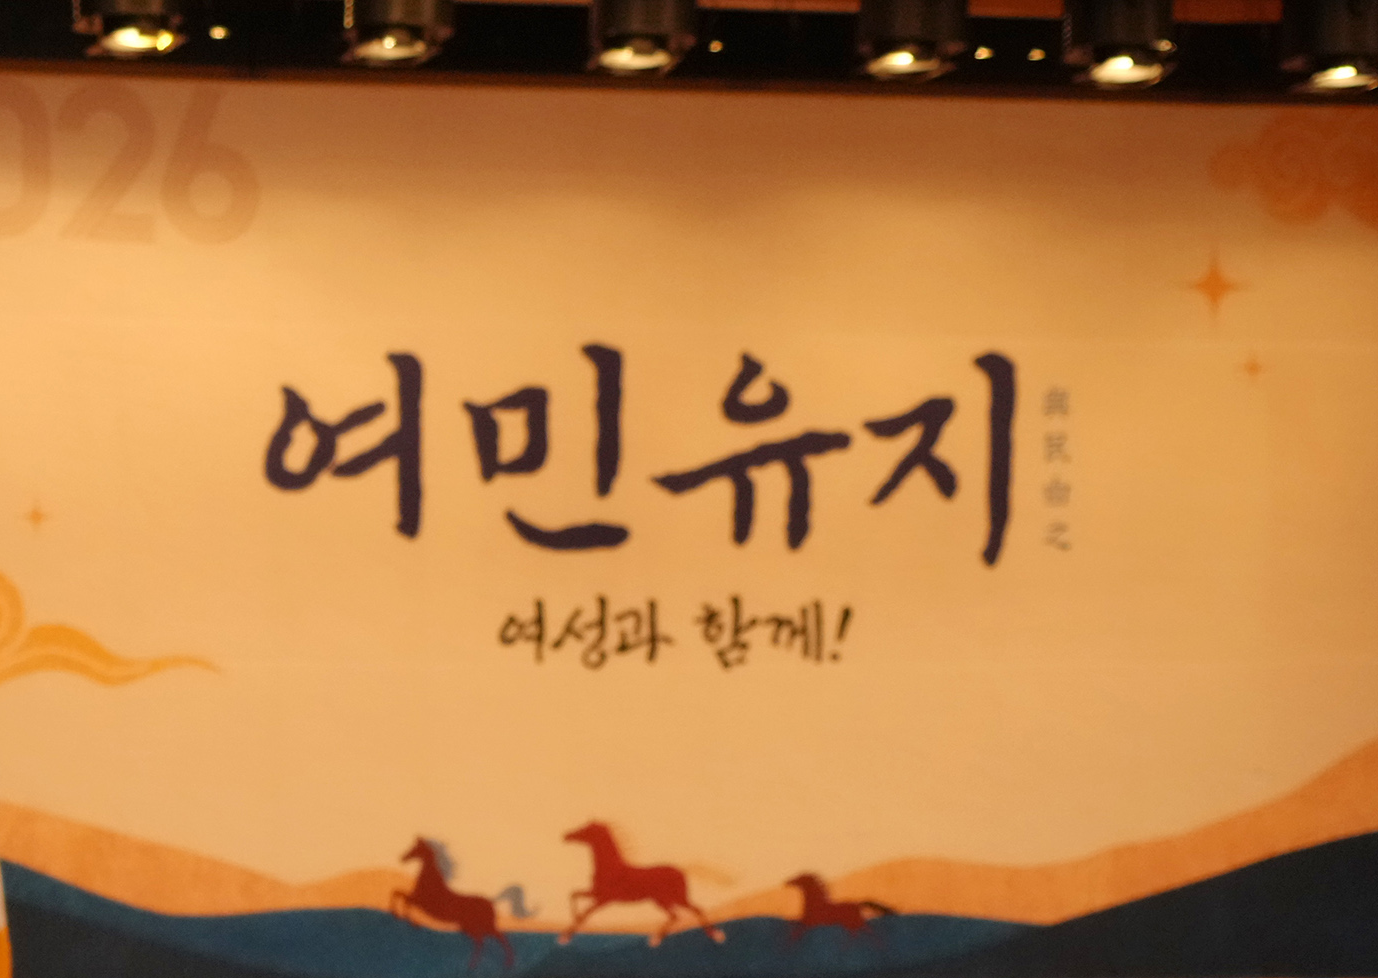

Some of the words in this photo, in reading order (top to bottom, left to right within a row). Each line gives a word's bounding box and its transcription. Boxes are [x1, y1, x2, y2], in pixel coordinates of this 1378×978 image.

[265, 343, 1016, 567] 여민유지
[499, 597, 671, 669] 여성과
[694, 596, 853, 669] 함께!
